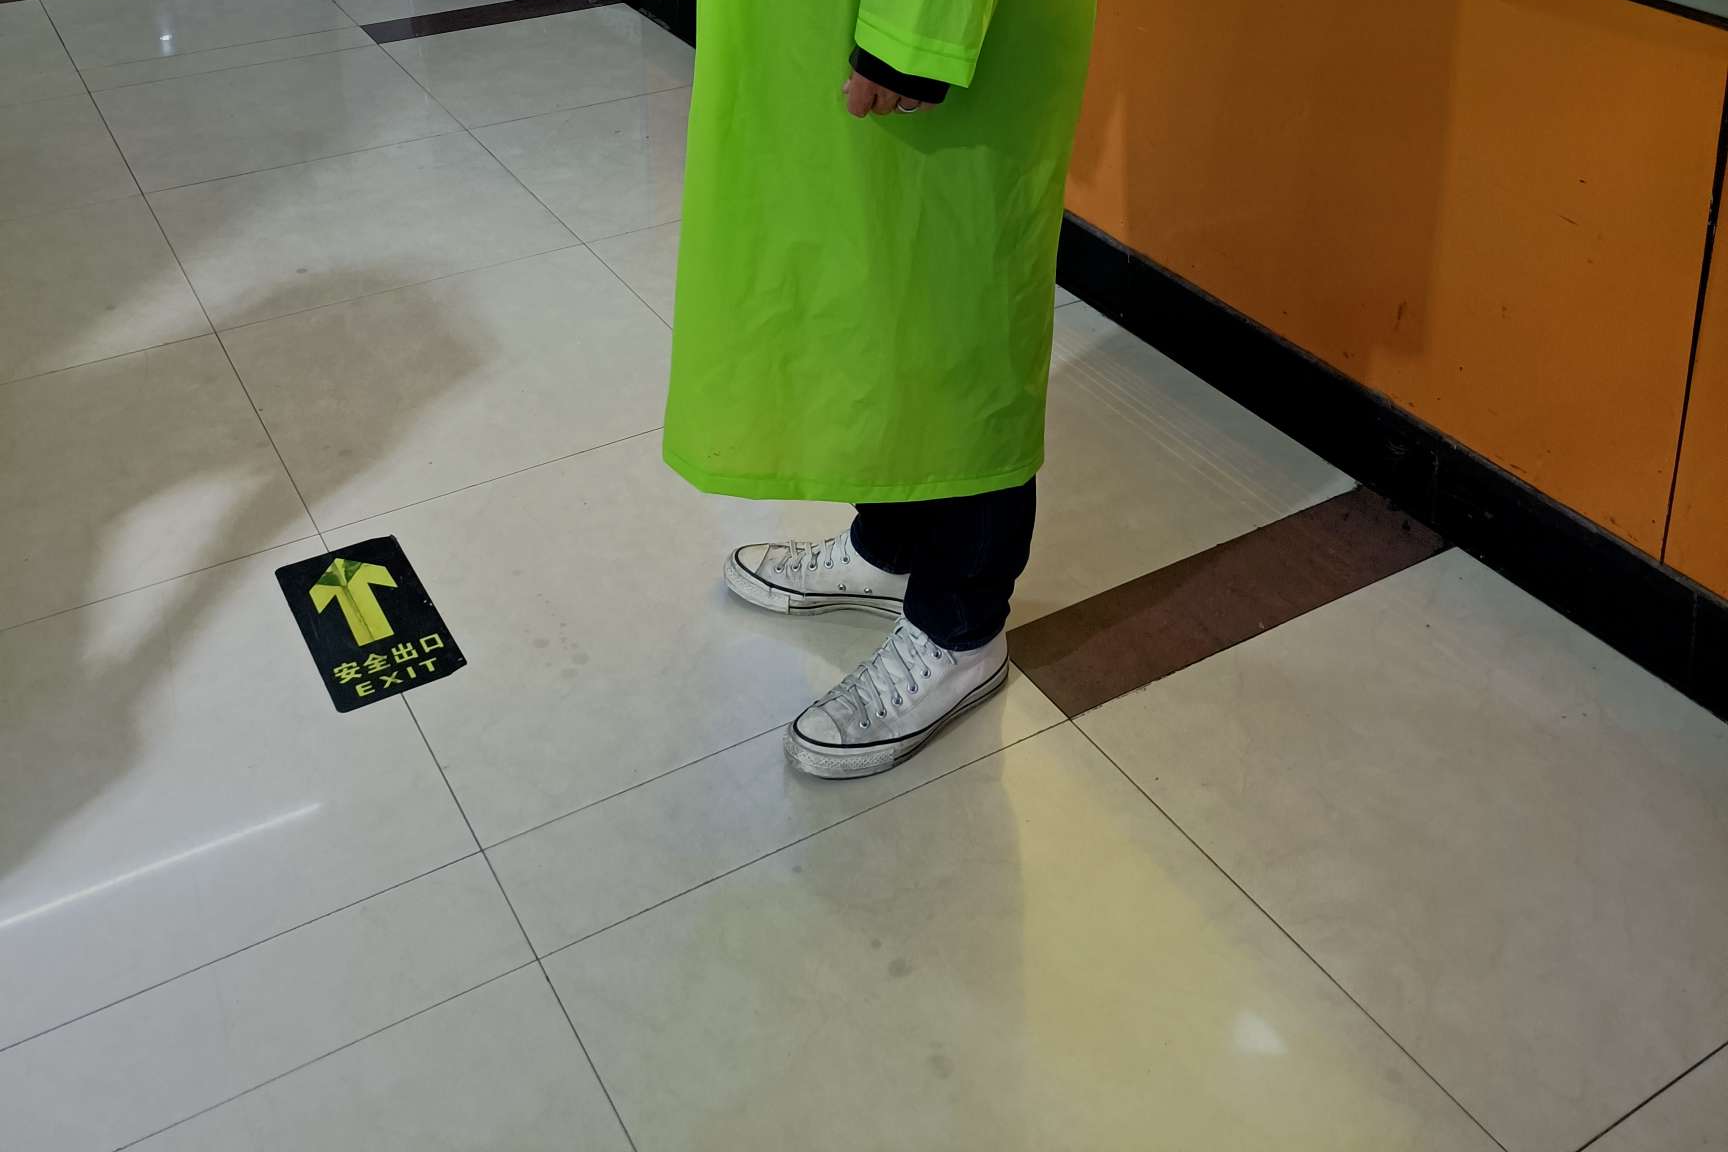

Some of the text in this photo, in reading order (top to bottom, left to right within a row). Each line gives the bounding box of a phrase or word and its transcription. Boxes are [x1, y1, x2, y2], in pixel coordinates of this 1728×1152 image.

[333, 633, 445, 684] 安全出口
[355, 657, 438, 697] EXIT
